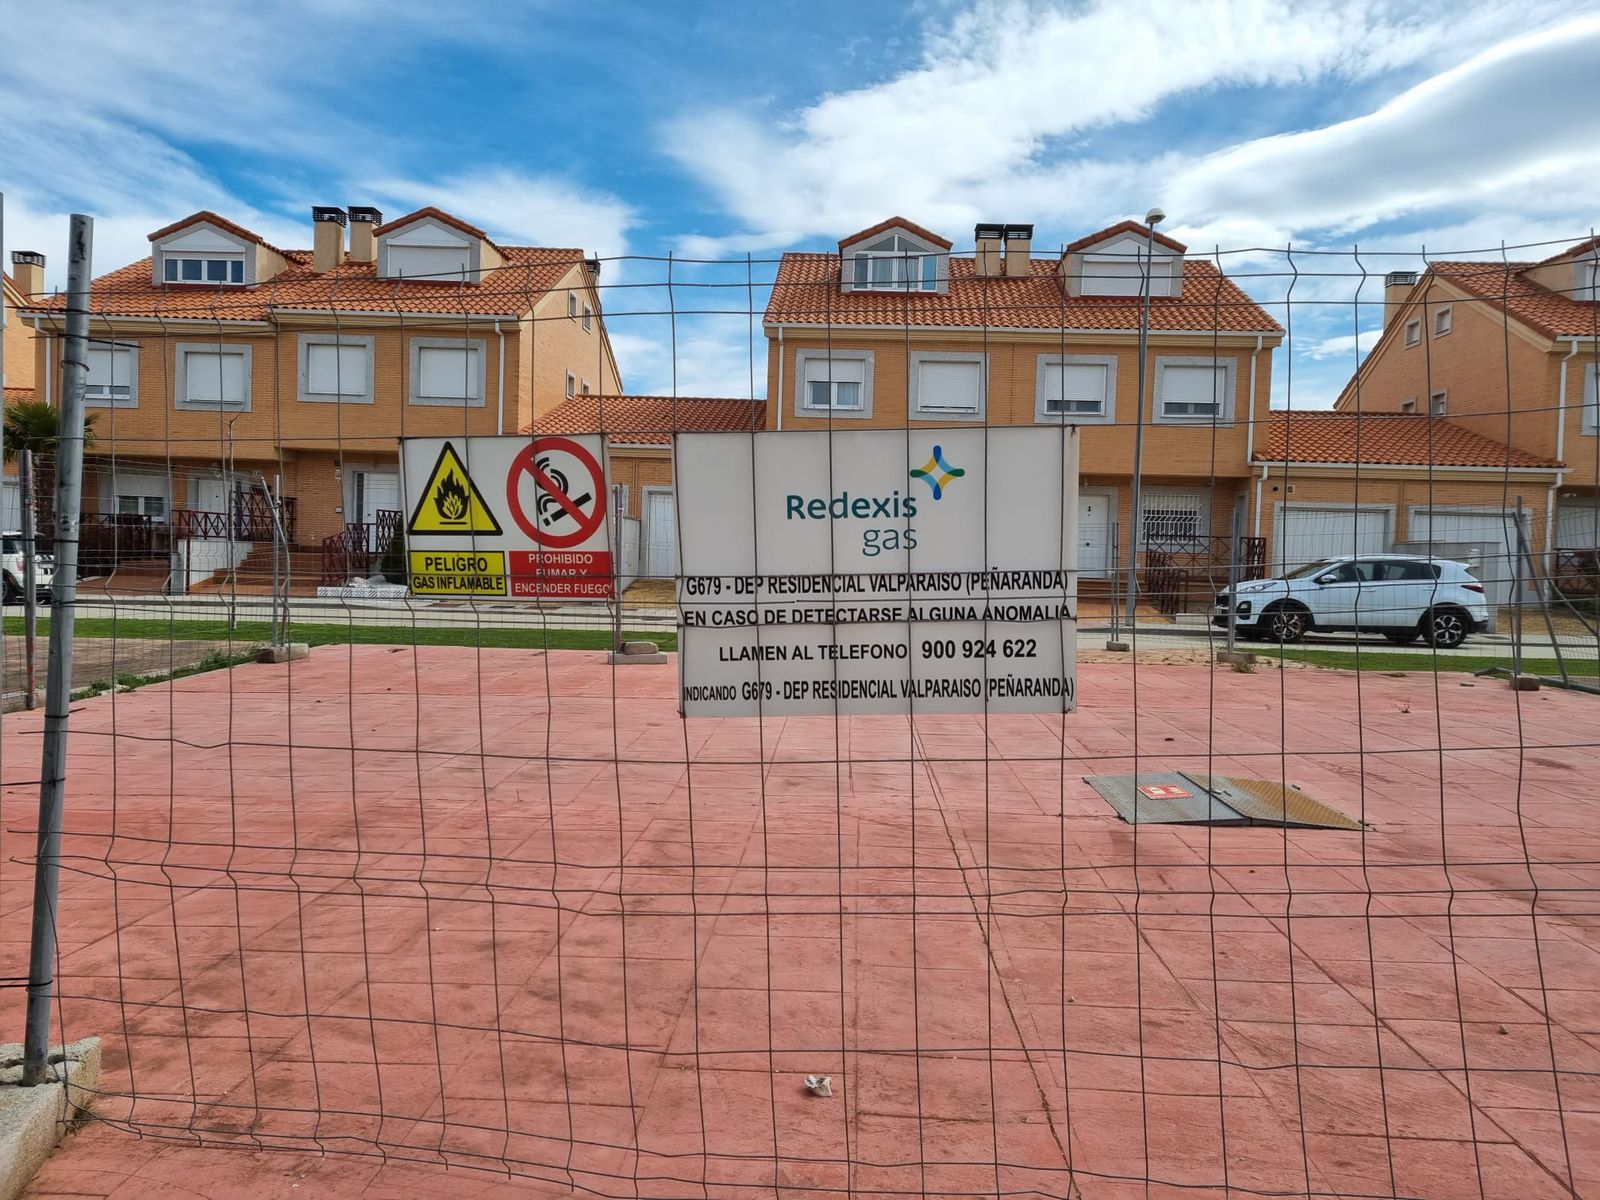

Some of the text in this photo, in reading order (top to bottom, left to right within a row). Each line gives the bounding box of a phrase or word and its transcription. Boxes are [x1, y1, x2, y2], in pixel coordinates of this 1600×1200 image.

[786, 491, 918, 520] Redexis
[862, 527, 918, 557] gas
[425, 557, 488, 572] PELIGRO
[528, 553, 593, 564] PROHIBIDO
[413, 577, 504, 590] GAS INFLAMABLE
[515, 583, 610, 594] ENCENDER FUEGO
[686, 576, 722, 595] G679
[734, 576, 764, 595] DEP
[768, 575, 866, 594] RESIDENCIAL
[869, 574, 961, 592] VALPARAISO
[684, 605, 1071, 626] EN CASO DE DETECTARSE ALGUNA ANOMALIA
[719, 639, 1037, 661] LLAMEN AL TELEFONO 900 924 622
[742, 681, 772, 700] G679
[783, 681, 809, 699] DEP
[812, 679, 897, 699] RESIDENCIAL
[901, 678, 981, 698] VALPARAISO
